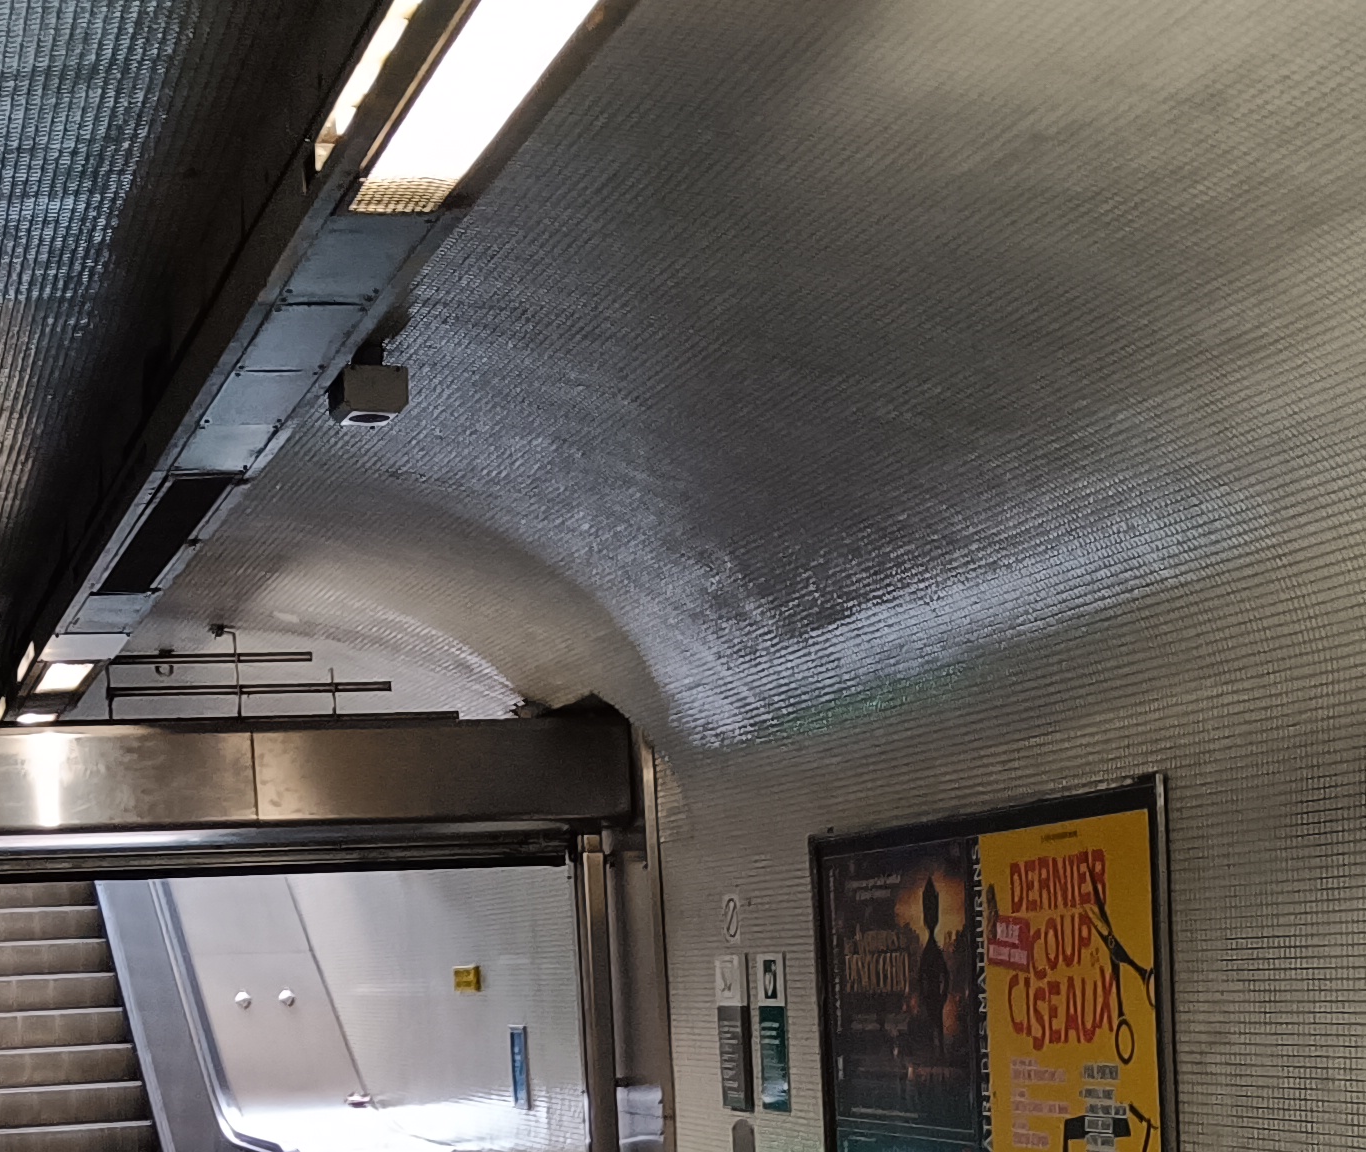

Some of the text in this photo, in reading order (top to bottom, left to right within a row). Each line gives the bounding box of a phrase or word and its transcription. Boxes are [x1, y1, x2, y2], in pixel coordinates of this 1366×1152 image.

[1010, 849, 1107, 914] DERNIER
[1031, 913, 1092, 980] COUP
[1008, 965, 1115, 1051] CISEAUX
